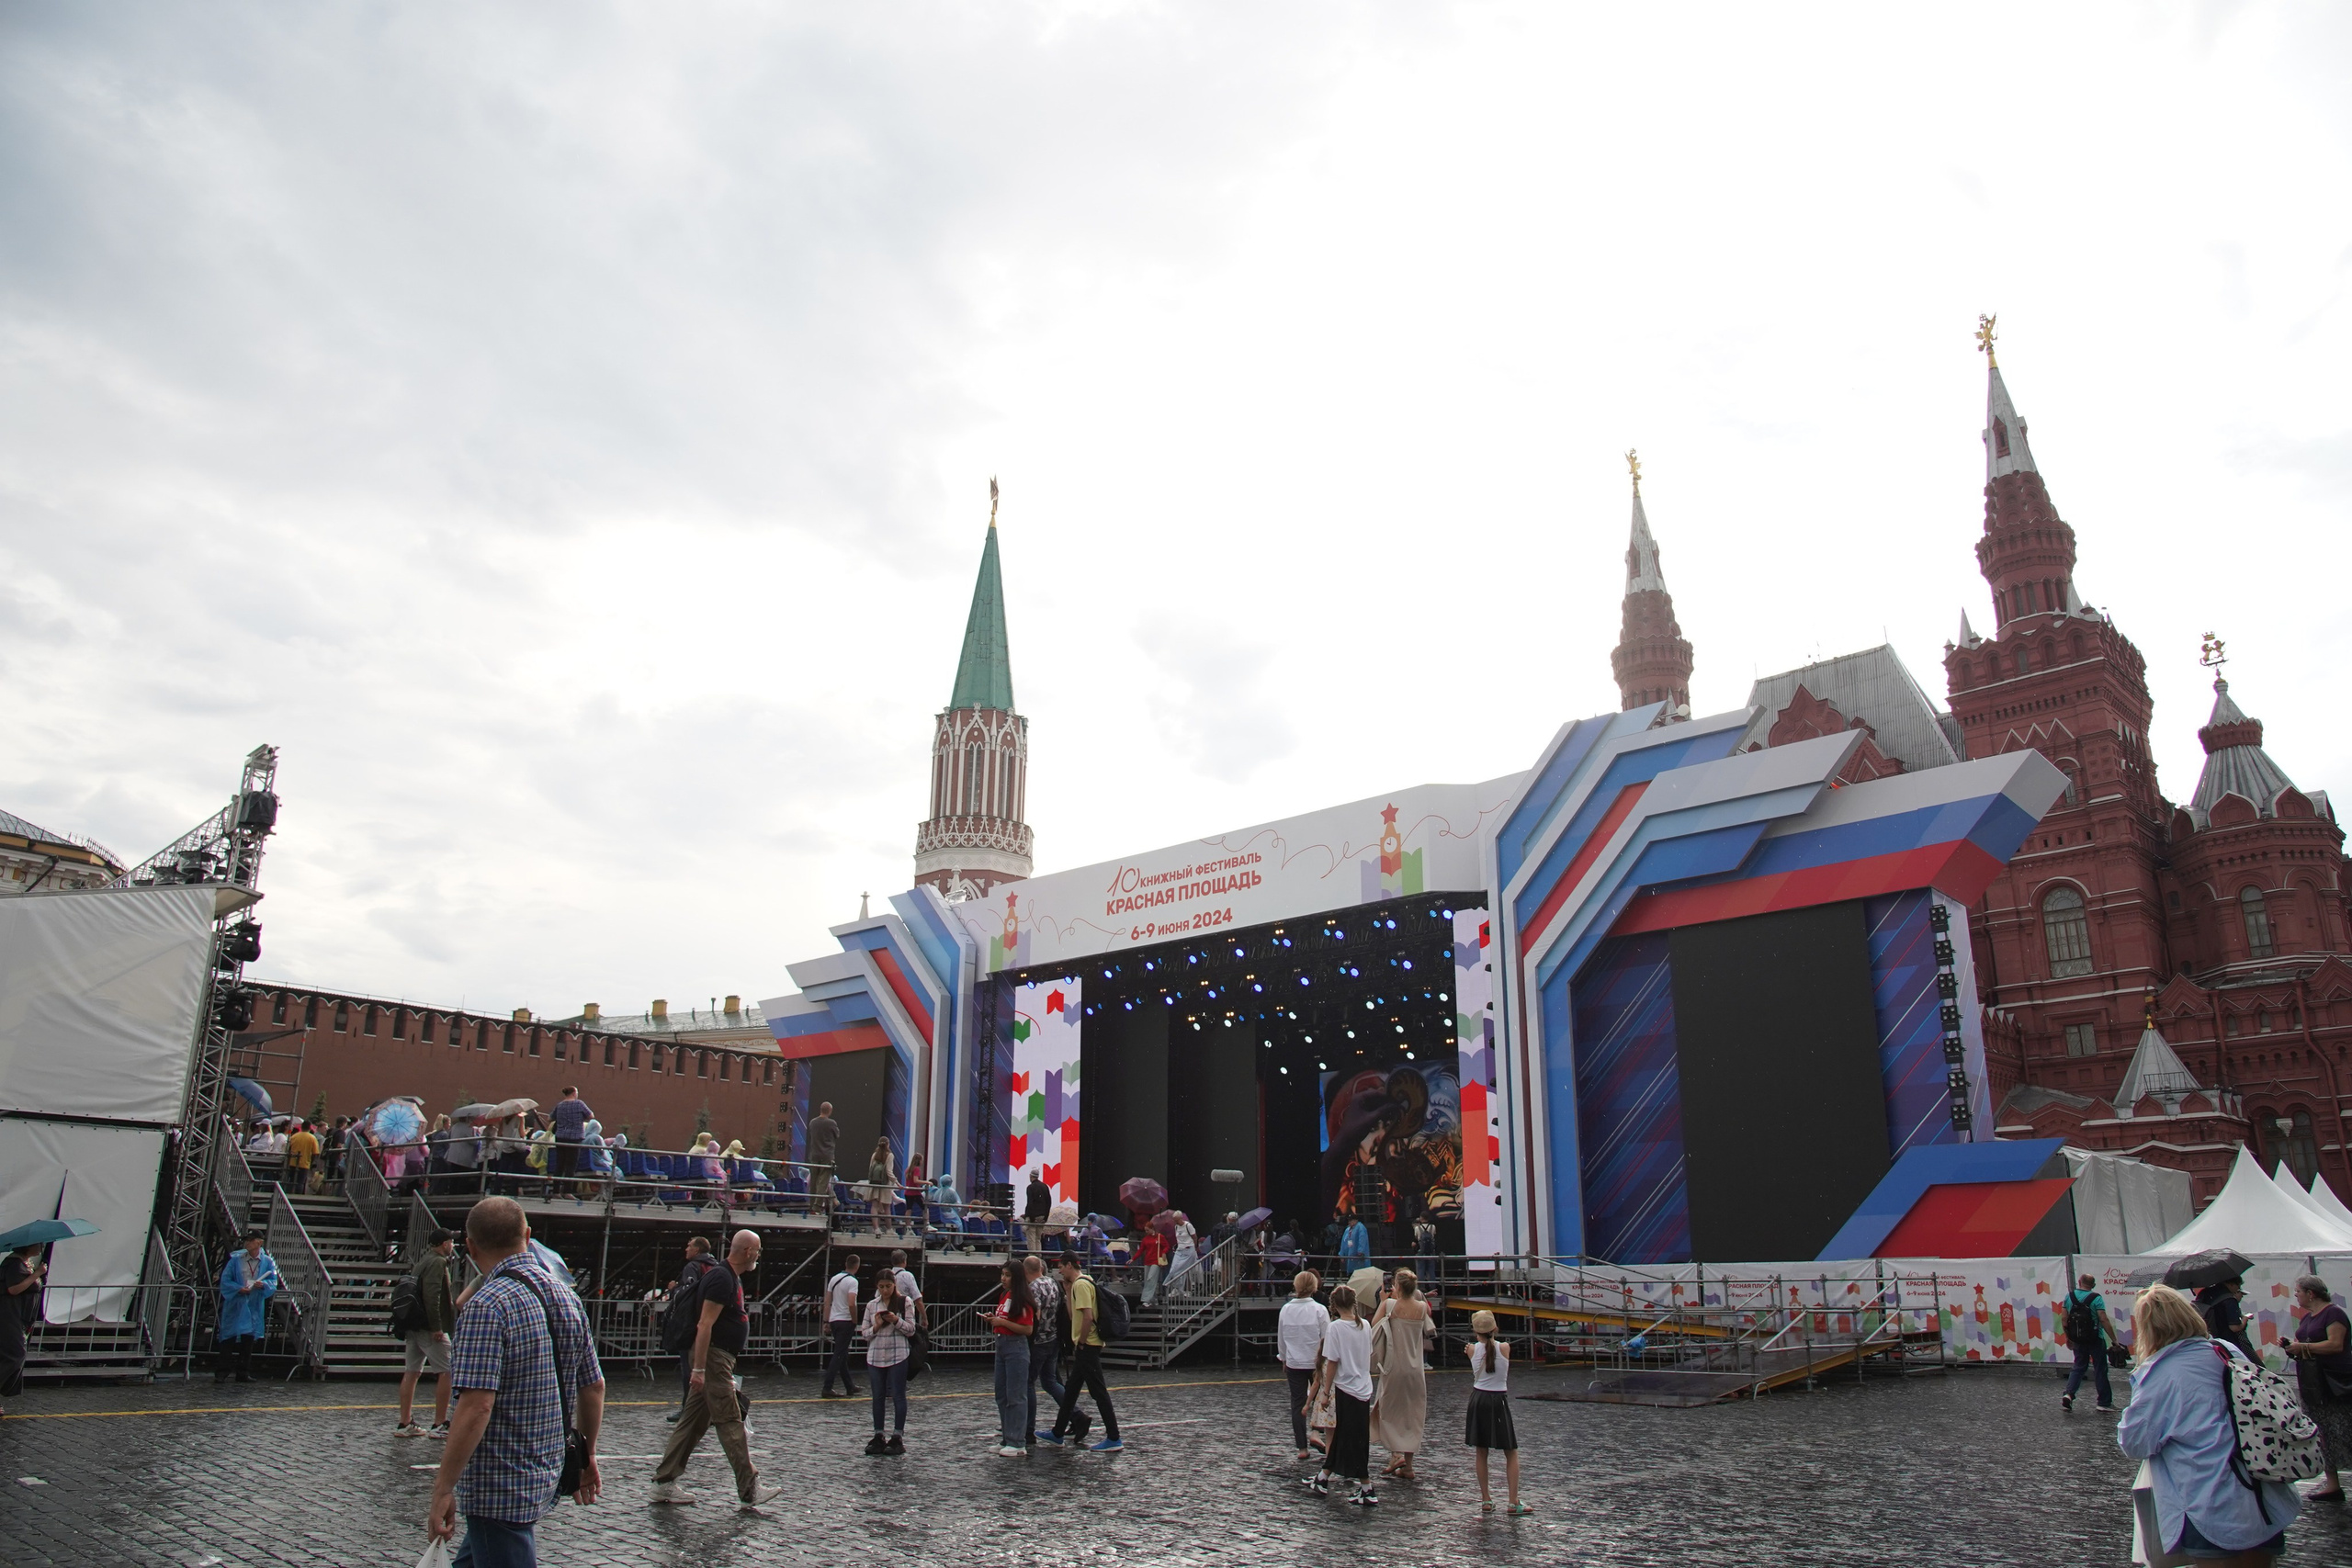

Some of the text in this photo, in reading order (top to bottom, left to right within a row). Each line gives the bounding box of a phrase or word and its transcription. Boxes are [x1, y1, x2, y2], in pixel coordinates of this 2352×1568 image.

[1106, 870, 1261, 916] КРАСНАЯ ПЛОЩАДЬ
[1107, 852, 1261, 897] 10 КНИЖНЫЙ ФЕСТИВАЛЬ
[1130, 923, 1155, 941] 6-9
[1193, 908, 1233, 930] 2024
[2103, 1267, 2120, 1278] 10
